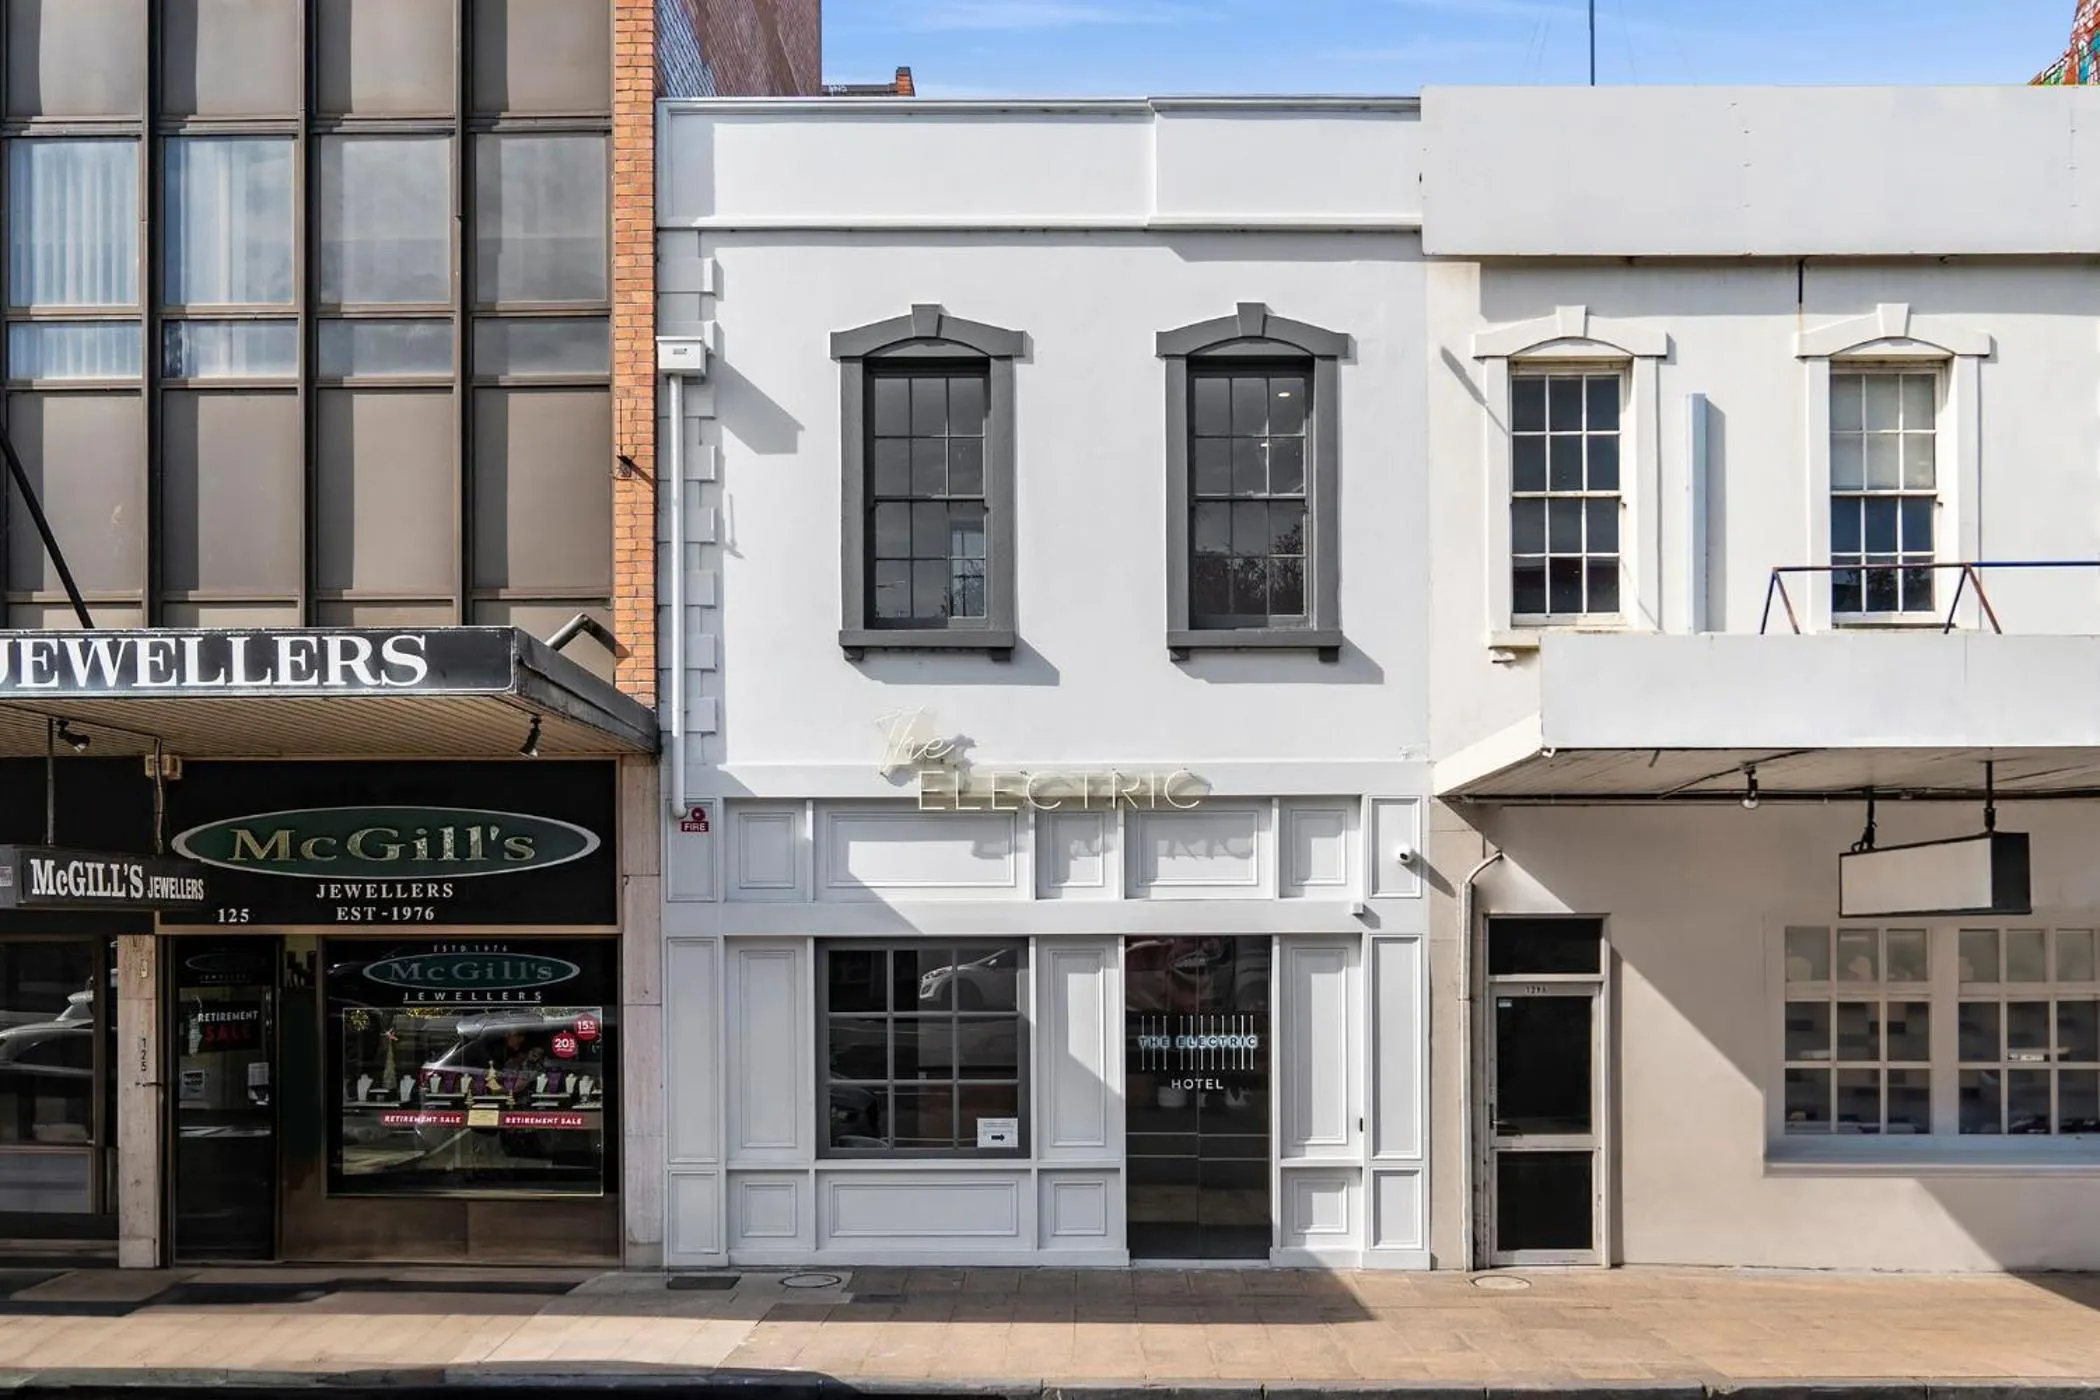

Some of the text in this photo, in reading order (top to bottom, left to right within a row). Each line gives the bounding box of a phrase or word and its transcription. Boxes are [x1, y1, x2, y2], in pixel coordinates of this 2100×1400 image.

[874, 704, 955, 776] The
[918, 769, 1200, 810] ELECTRIC
[683, 822, 707, 831] FIRE
[227, 826, 536, 862] McGill's
[30, 858, 144, 899] McGILL'S
[147, 875, 204, 901] JEWELLERS
[316, 883, 454, 899] JEWELLERS
[217, 908, 249, 923] 125
[388, 960, 554, 981] McGill's
[402, 991, 542, 1001] JEWELLERS
[197, 1010, 260, 1023] RETIREMENT
[1138, 1035, 1258, 1049] THE ELECTRIC
[1171, 1078, 1224, 1090] HOTEL
[384, 1115, 438, 1124] RETIREMENT
[440, 1115, 462, 1124] SALE
[505, 1117, 559, 1125] RETIREMENT
[560, 1117, 583, 1126] SALE
